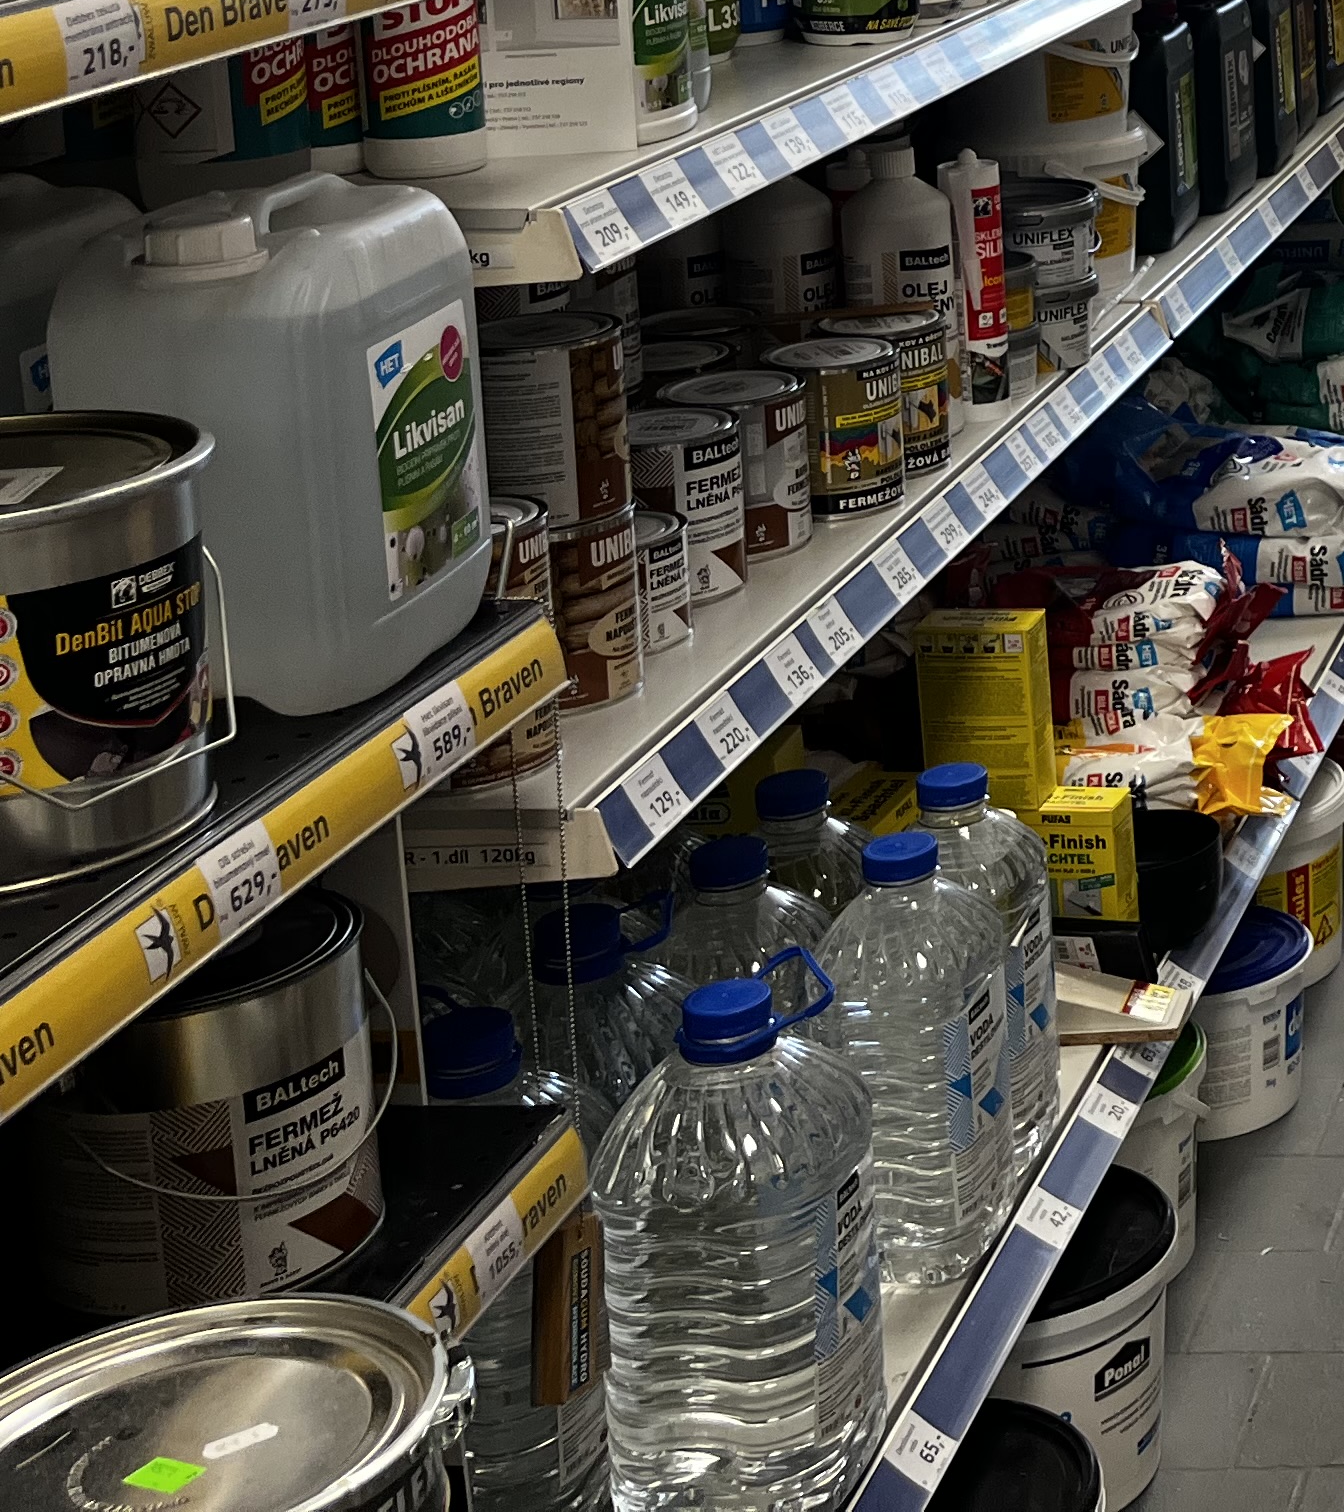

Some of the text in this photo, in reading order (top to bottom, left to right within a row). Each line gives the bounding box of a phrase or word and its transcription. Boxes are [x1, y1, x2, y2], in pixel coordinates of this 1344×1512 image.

[165, 4, 215, 43] Den
[82, 41, 136, 76] 218,-
[373, 35, 480, 84] OCHRANA
[383, 87, 410, 103] PROTI
[489, 76, 585, 90] pro jednotlivé regiony
[665, 191, 699, 214] 149,-
[594, 220, 631, 248] 209,-
[1011, 226, 1075, 246] UNIFLEX
[903, 253, 950, 269] BALtech
[902, 279, 948, 299] OLEJ
[380, 350, 399, 376] HET
[393, 397, 466, 460] Likvisan
[686, 487, 729, 512] LNĚNÁ
[1282, 497, 1298, 524] HET
[55, 594, 173, 657] DenBit AQUA
[107, 619, 182, 668] BITUMENOVÁ
[93, 636, 192, 690] OPRAVNÁ HMOTA
[786, 663, 816, 691] 136,-
[478, 655, 545, 719] Braven
[432, 721, 472, 763] 589,-
[719, 727, 754, 756] 220,-
[649, 787, 683, 820] 129,-
[1041, 813, 1072, 826] PUFAS
[229, 871, 281, 915] 629,-
[255, 1060, 341, 1110] BALtech
[247, 1090, 345, 1157] FERMEŽ
[249, 1106, 362, 1177] LNĚNÁ P6420
[489, 1238, 523, 1281] 1055,-
[1104, 1345, 1145, 1388] Ponal
[919, 1433, 946, 1464] 65,-
